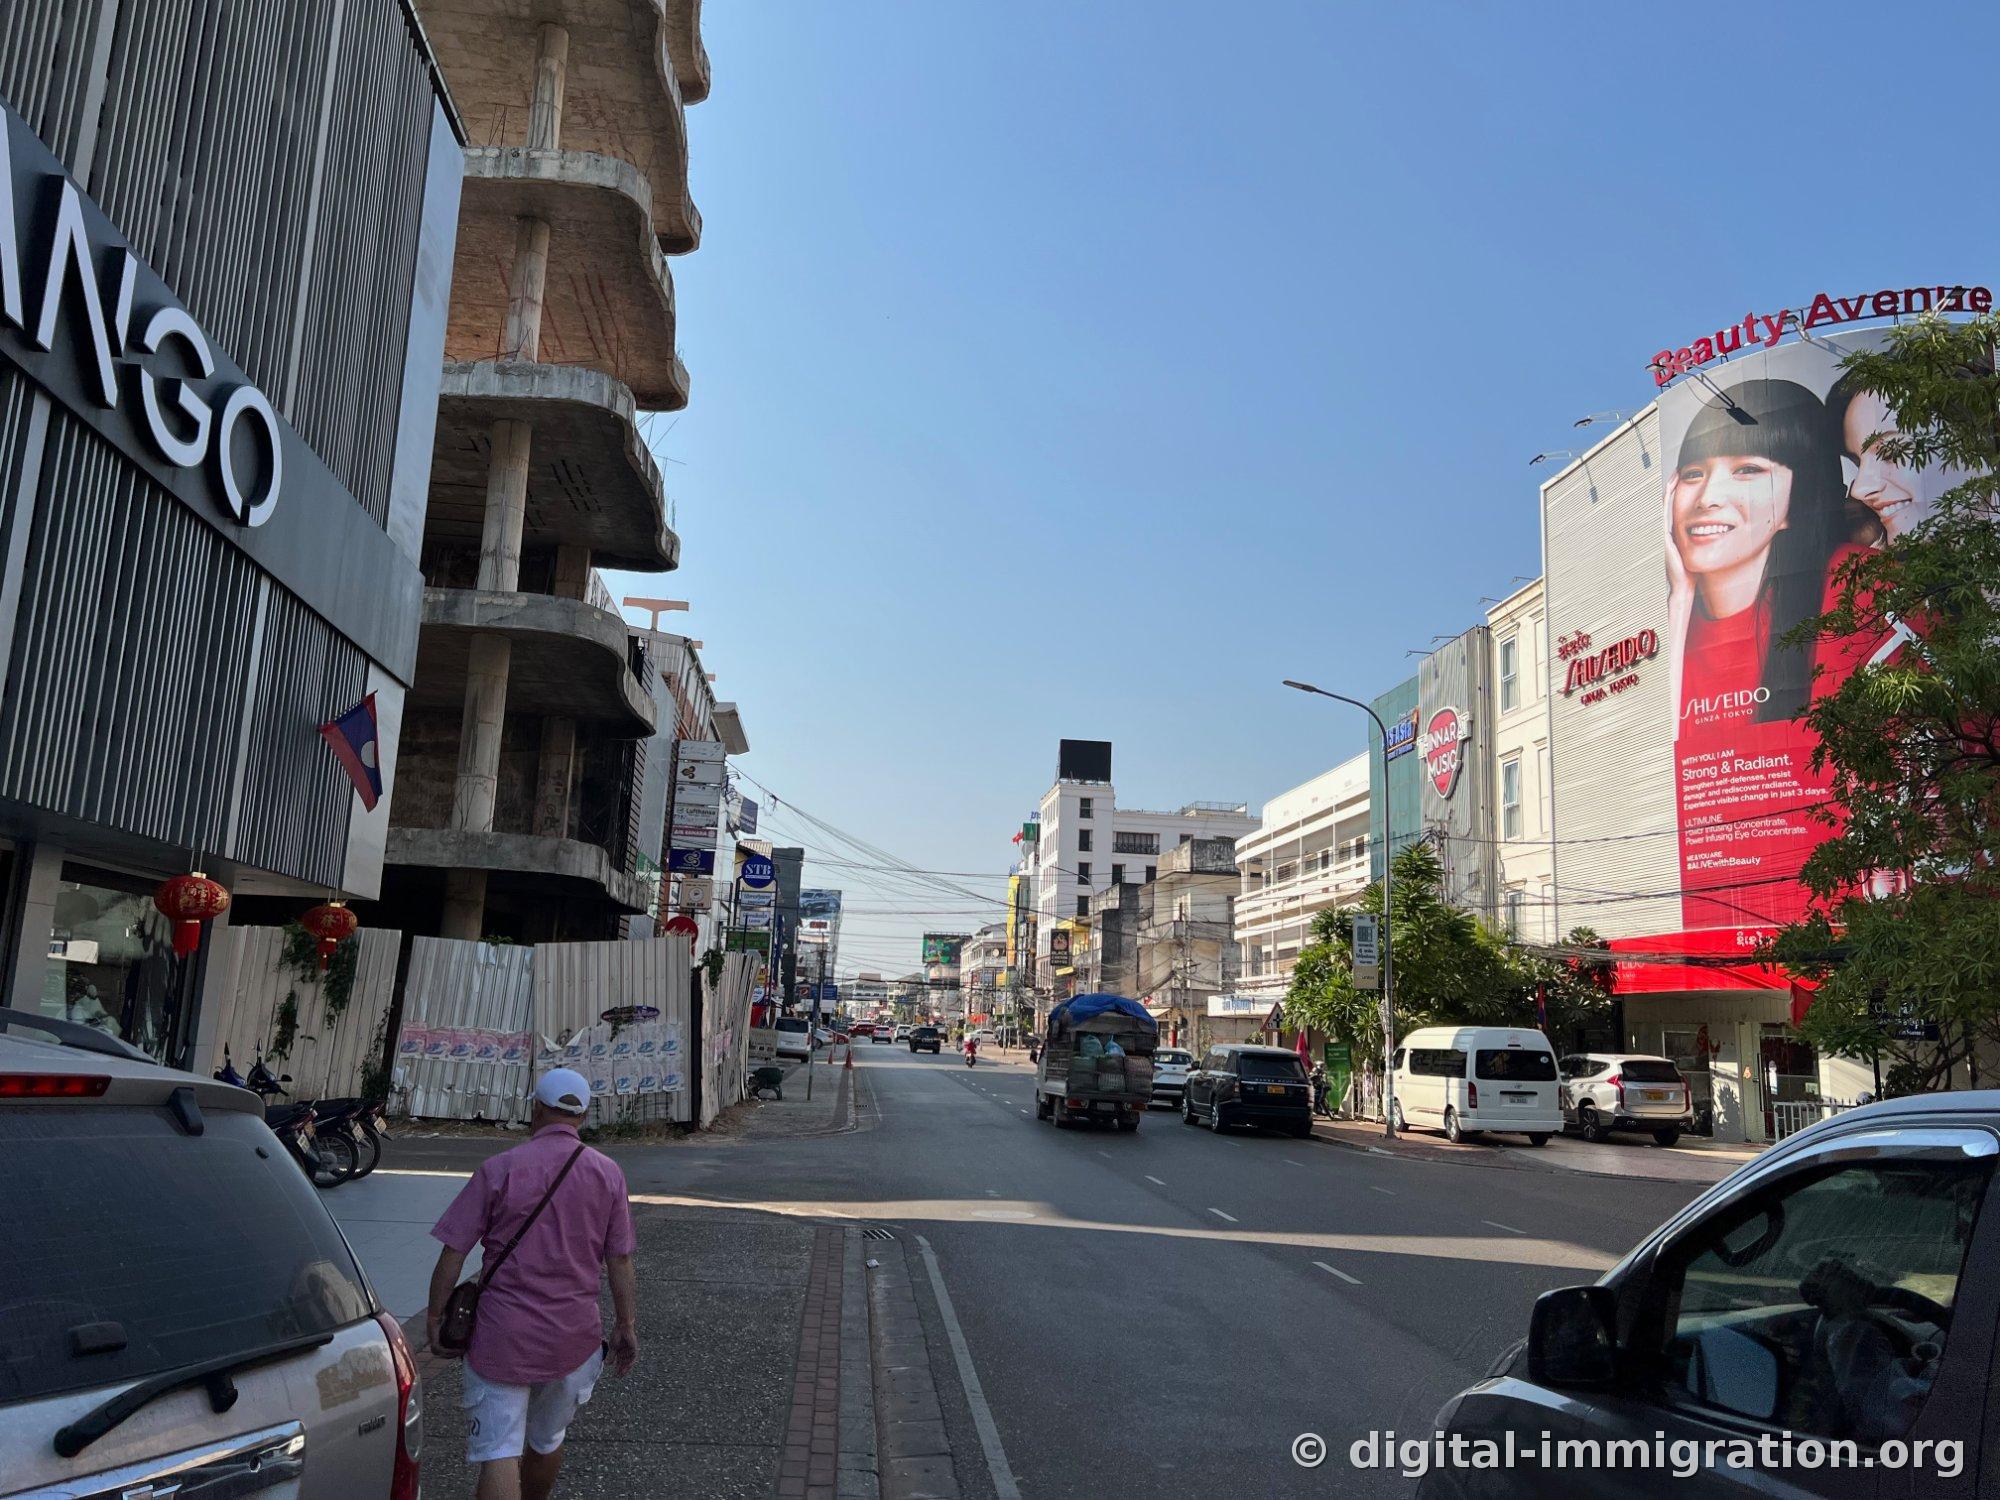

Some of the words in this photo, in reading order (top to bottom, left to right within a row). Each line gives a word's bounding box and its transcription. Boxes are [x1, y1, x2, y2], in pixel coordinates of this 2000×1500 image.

[0, 106, 282, 527] NGO
[1650, 309, 1788, 386] Beauty
[1804, 286, 1992, 329] Avenue
[1680, 687, 1770, 719] SHISEIDO
[1695, 714, 1720, 725] GINZA
[1723, 708, 1753, 719] TOKYO
[1428, 749, 1457, 777] MUSIC
[1682, 756, 1698, 766] WITH
[1699, 752, 1716, 762] YOU,
[1721, 749, 1734, 758] AM
[1682, 766, 1718, 781] Strong
[1721, 761, 1732, 774] &
[1734, 754, 1793, 772] Radiant.
[1682, 781, 1715, 792] Strengthen
[1768, 770, 1791, 779] resist
[1708, 788, 1721, 797] and
[1722, 785, 1760, 795] rediscover
[1762, 780, 1800, 790] radiance.
[1683, 800, 1716, 811] Experience
[1717, 795, 1740, 805] visible
[1740, 792, 1769, 801] change
[1780, 789, 1795, 799] just
[1797, 788, 1803, 796] 3
[1805, 787, 1829, 796] days.
[1684, 813, 1723, 828] ULTIMUNE
[1705, 823, 1733, 834] Infusing
[1733, 818, 1788, 830] Concentrate,
[1685, 836, 1705, 846] Power
[1705, 832, 1733, 843] Infusing
[1734, 830, 1750, 840] Eye
[1751, 826, 1808, 838] Concentrate.
[745, 863, 772, 875] STB
